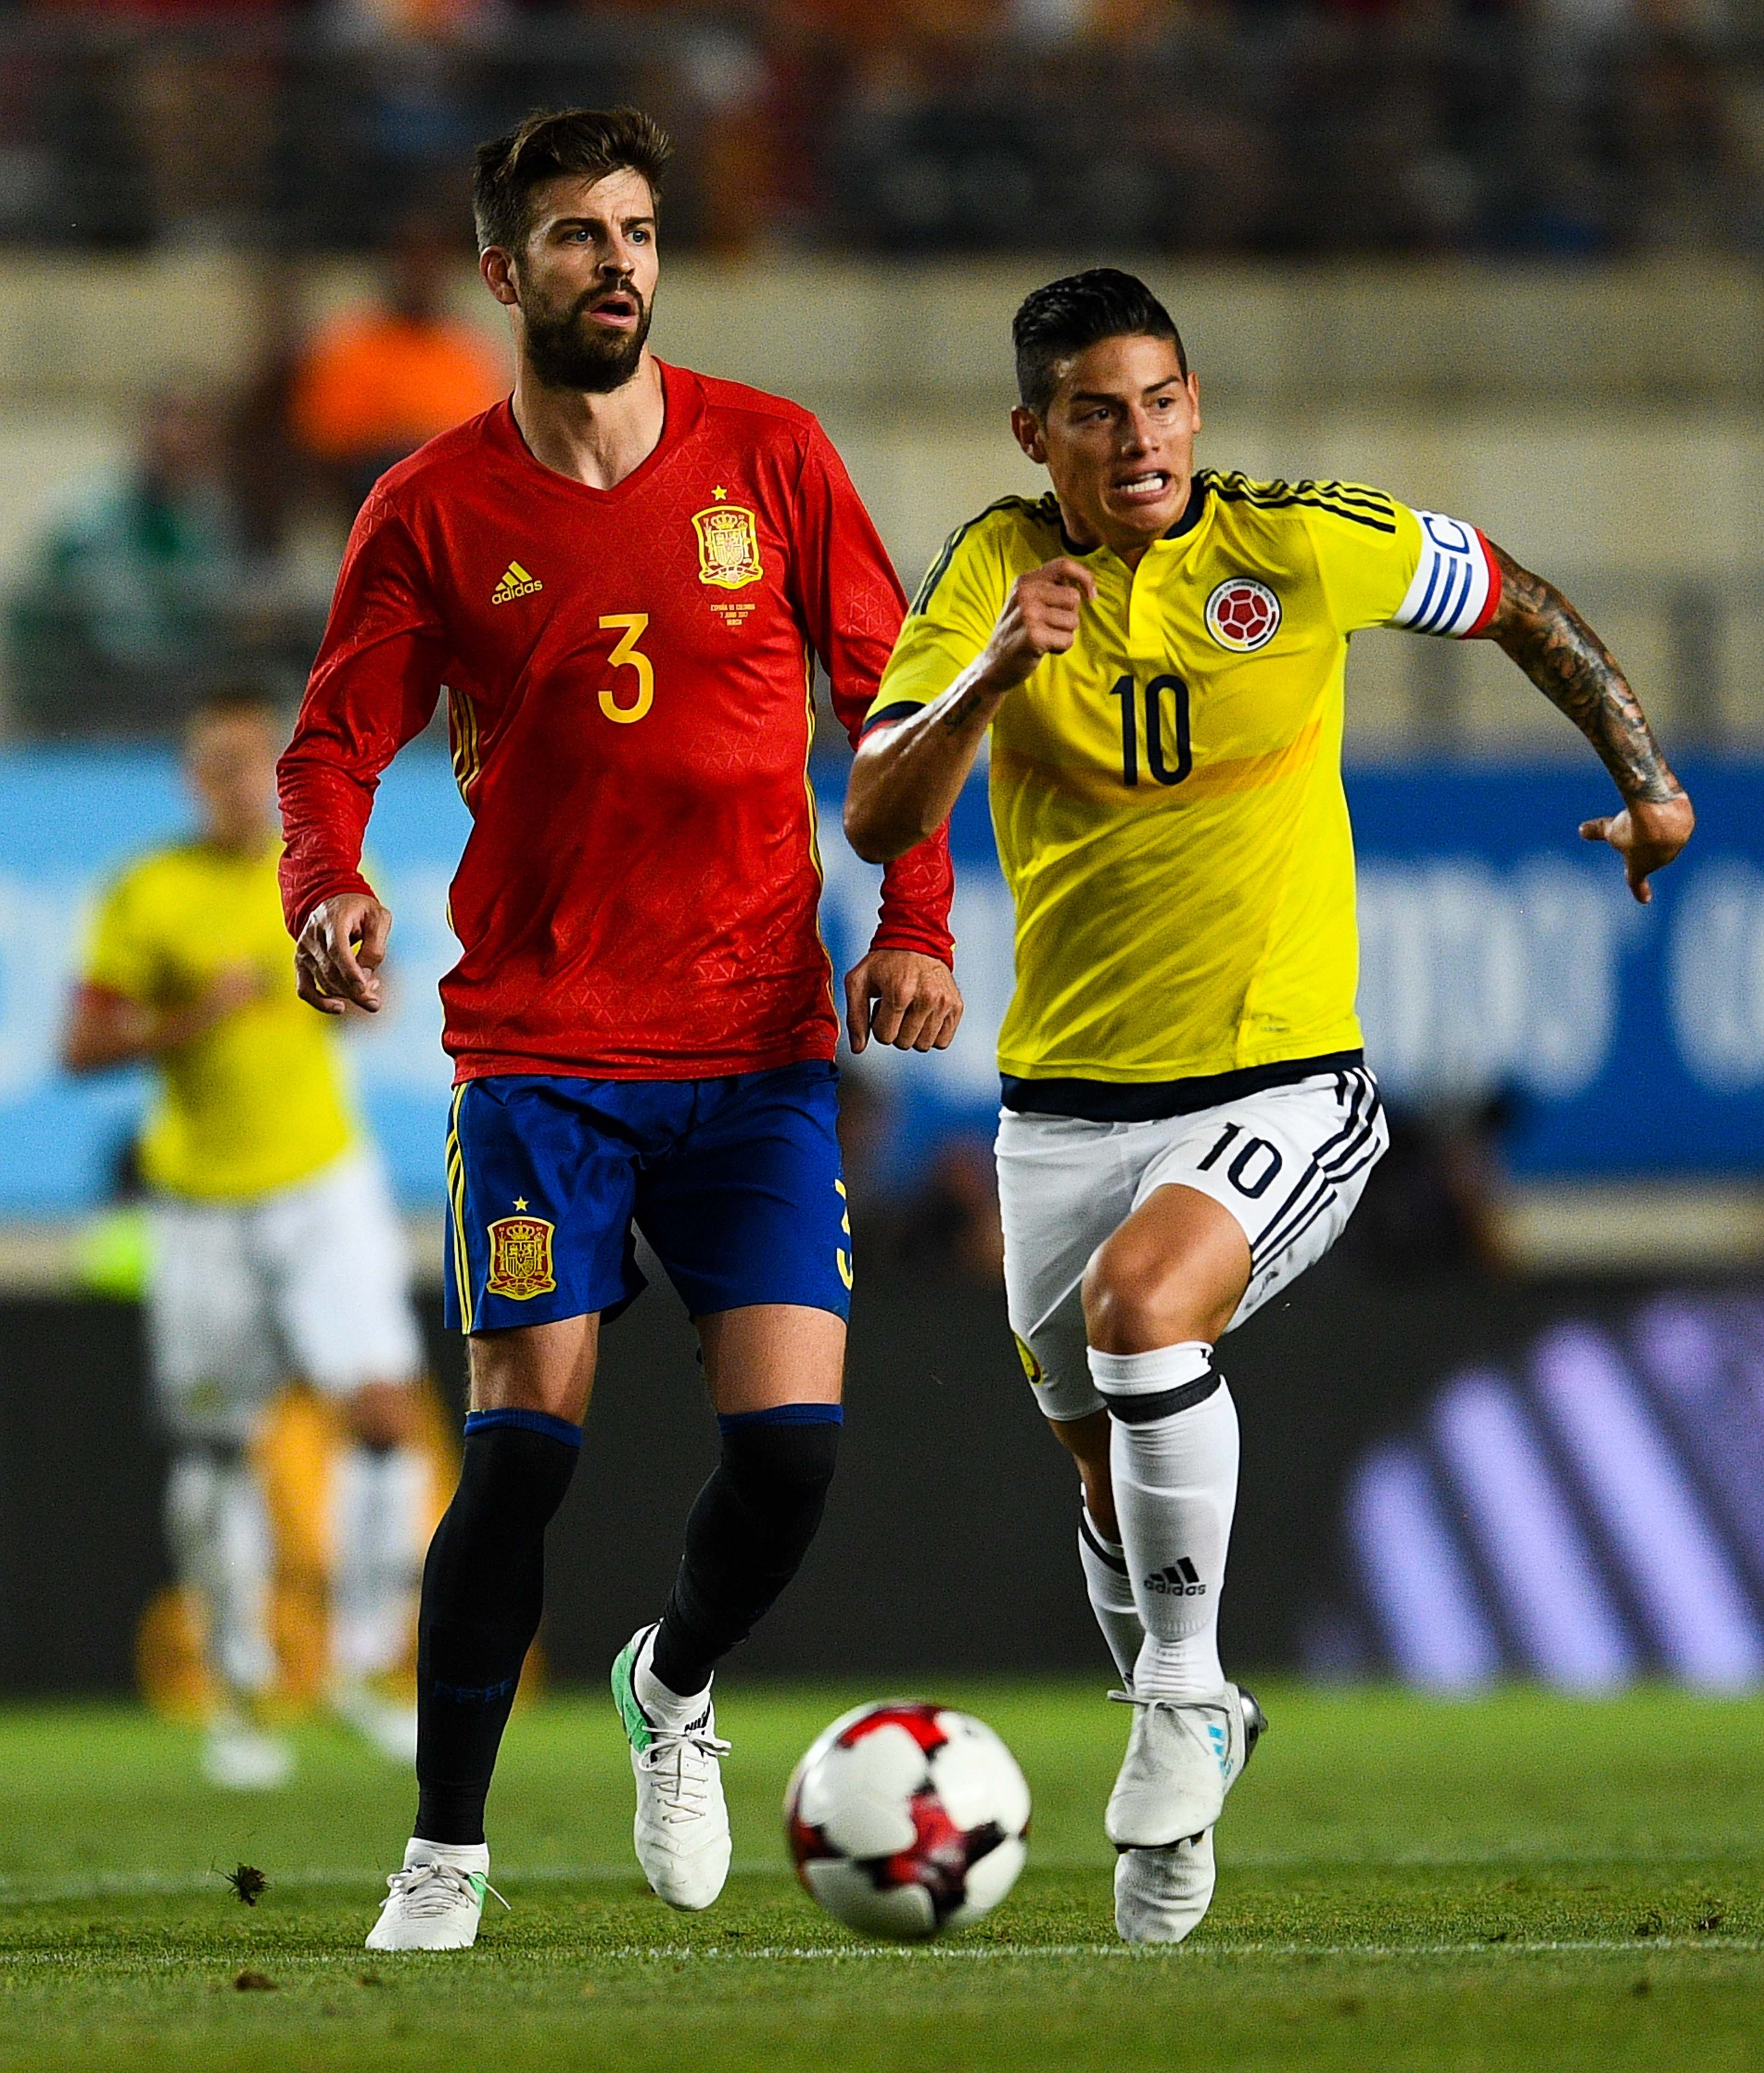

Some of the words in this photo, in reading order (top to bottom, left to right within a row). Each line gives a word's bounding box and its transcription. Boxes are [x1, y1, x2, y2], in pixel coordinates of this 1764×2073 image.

[492, 580, 543, 604] adidas
[598, 613, 654, 723] 3
[1109, 674, 1192, 785] 10
[1197, 1122, 1282, 1199] 10
[1144, 1579, 1206, 1597] adidas
